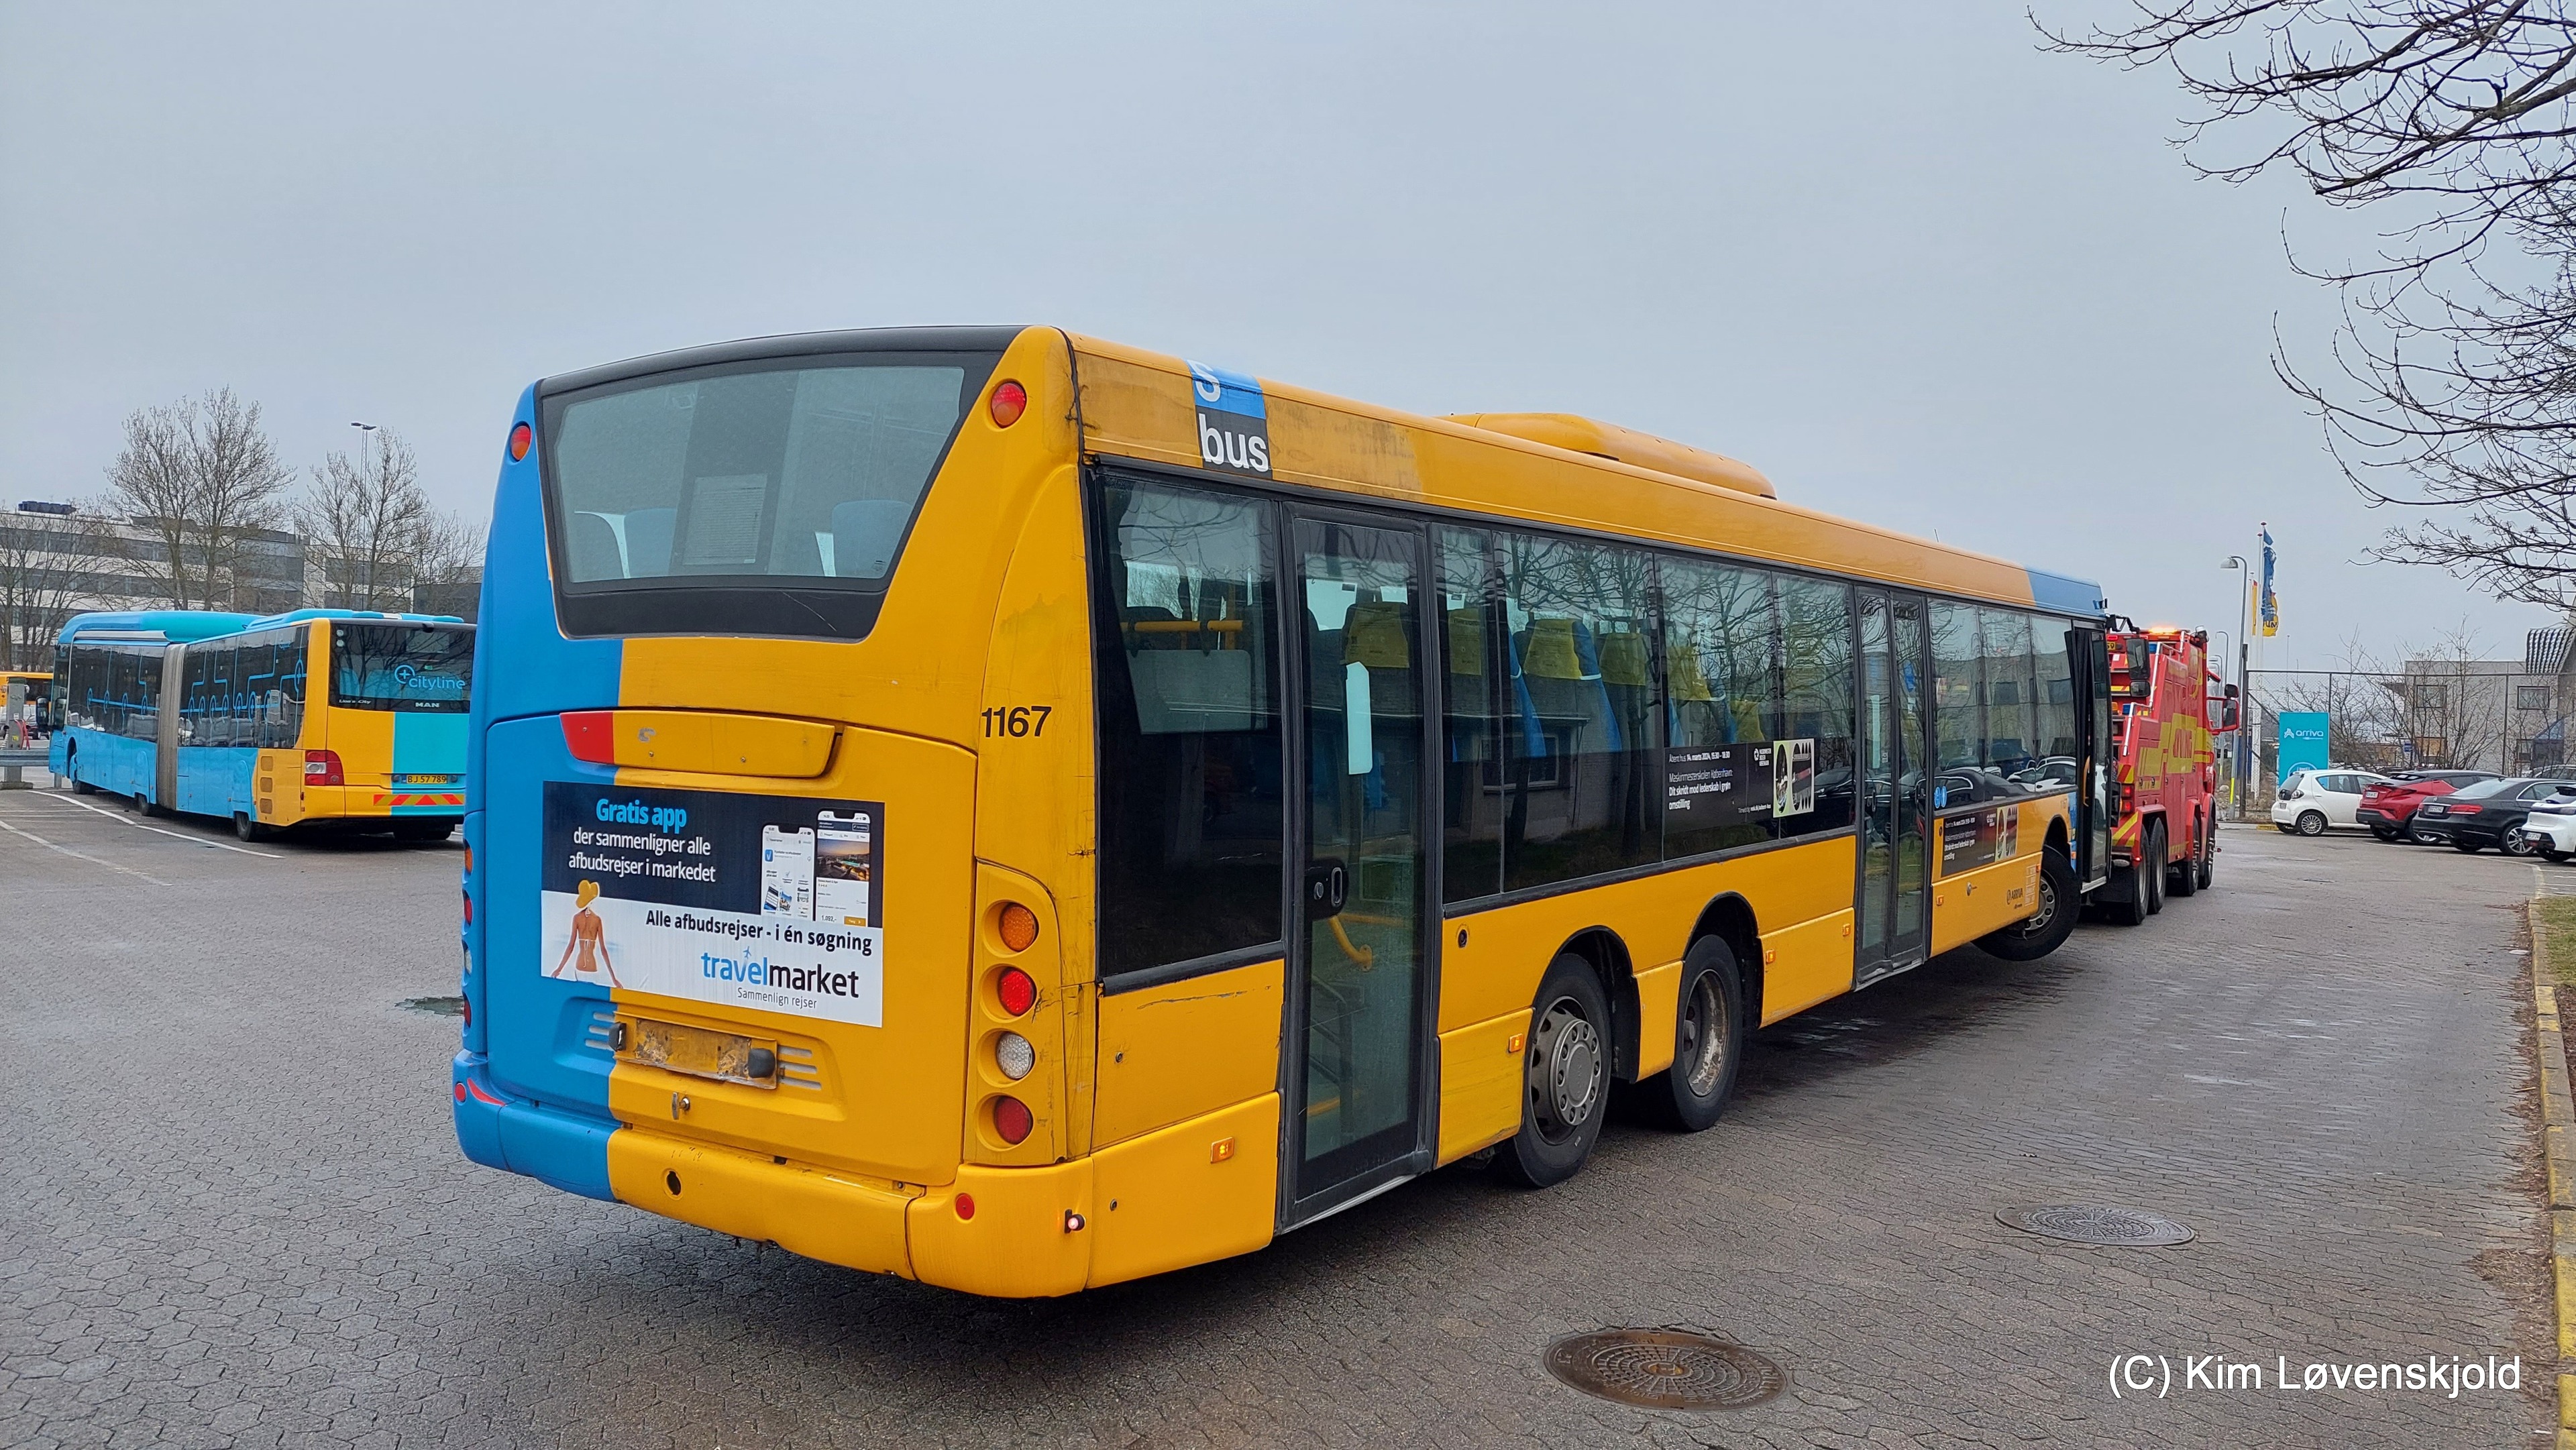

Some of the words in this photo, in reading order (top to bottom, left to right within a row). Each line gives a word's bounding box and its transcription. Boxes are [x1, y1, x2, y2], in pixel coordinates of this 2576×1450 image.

[1188, 359, 1222, 402] S
[1199, 413, 1270, 472] bus
[409, 675, 466, 690] cityline
[981, 706, 1052, 738] 1167
[2296, 728, 2324, 737] arriva
[1676, 785, 1689, 795] skridt
[1689, 783, 1699, 794] mod
[1721, 782, 1731, 793] grøn
[596, 799, 649, 826] Gratis
[652, 806, 687, 834] app
[574, 826, 594, 846] der
[596, 831, 685, 856] sammenligner
[688, 836, 710, 856] alle
[569, 852, 645, 878] afbudsrejser
[653, 860, 716, 883] markedet
[646, 910, 672, 929] Alle
[674, 913, 763, 942] afbudsrejser
[784, 922, 802, 943] én
[808, 930, 872, 957] søgning
[700, 952, 859, 999] travelmarket
[737, 987, 790, 1008] Sammenlign
[792, 994, 817, 1009] rejser
